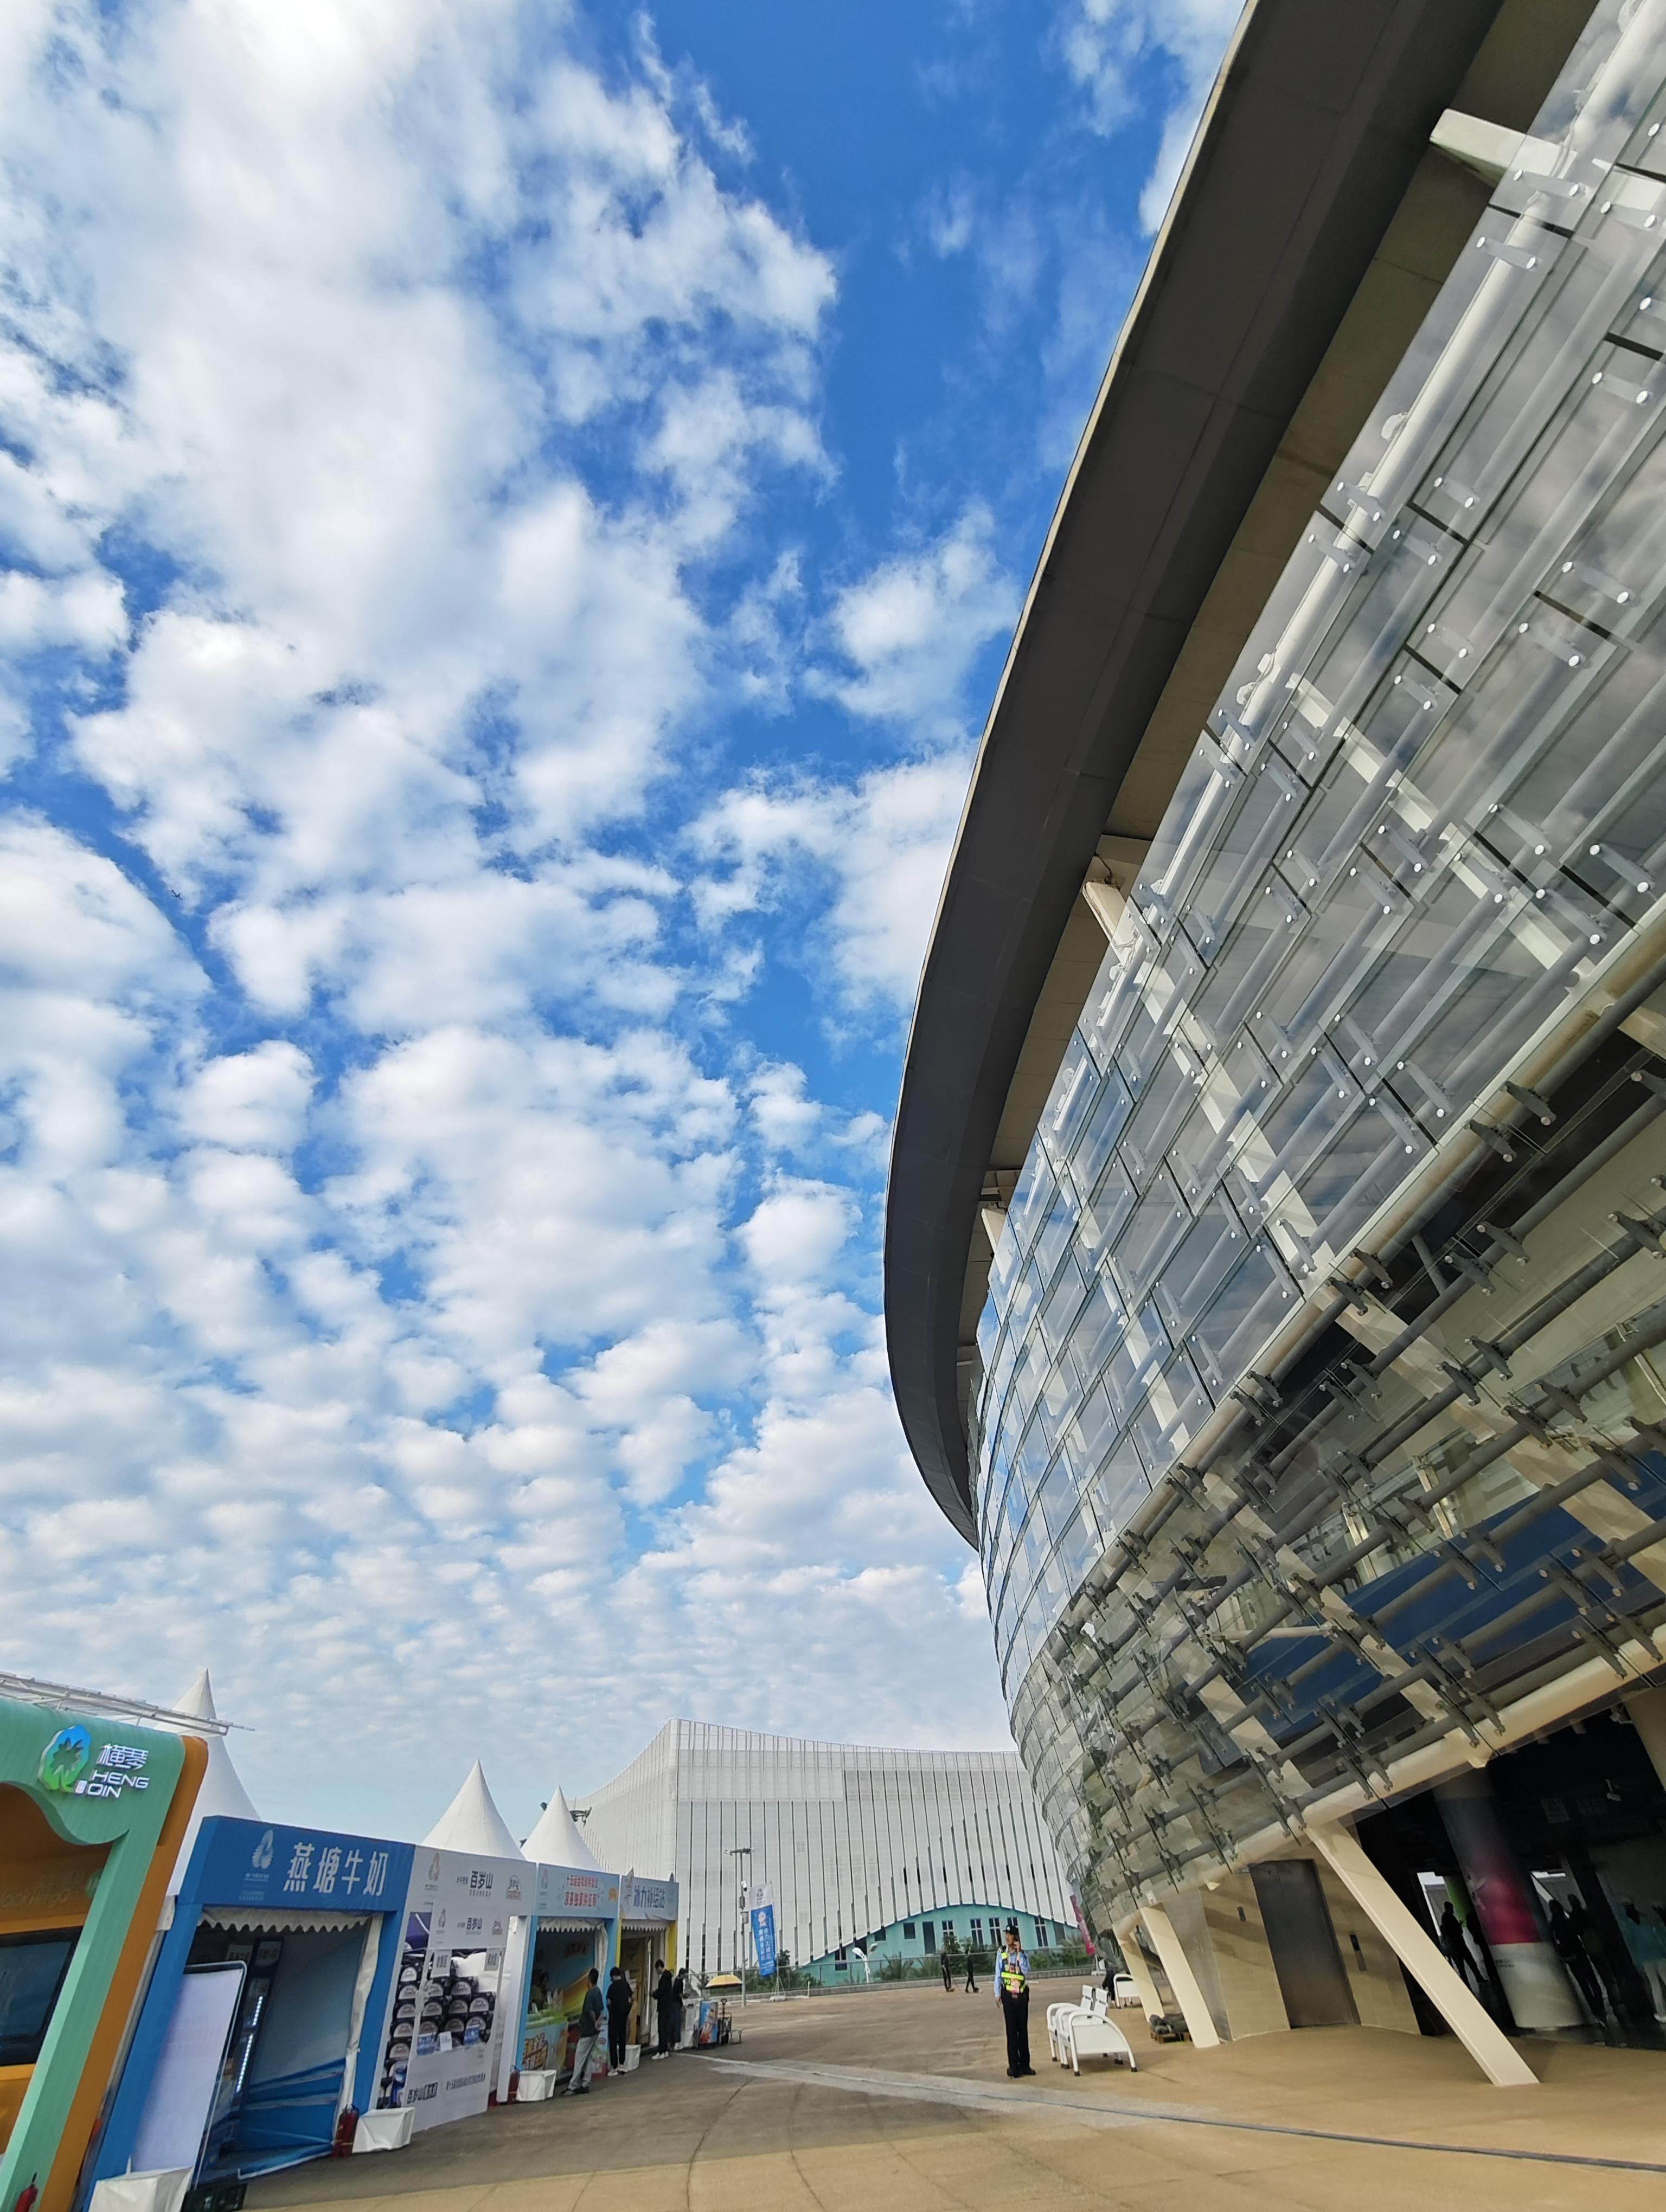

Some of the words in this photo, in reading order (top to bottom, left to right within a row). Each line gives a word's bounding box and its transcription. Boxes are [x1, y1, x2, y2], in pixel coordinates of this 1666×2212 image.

[97, 1743, 149, 1770] 横琴
[91, 1770, 150, 1789] HENG
[283, 1842, 388, 1896] 燕塘牛奶
[470, 1870, 493, 1889] 百岁山
[466, 1917, 483, 1930] 百岁山
